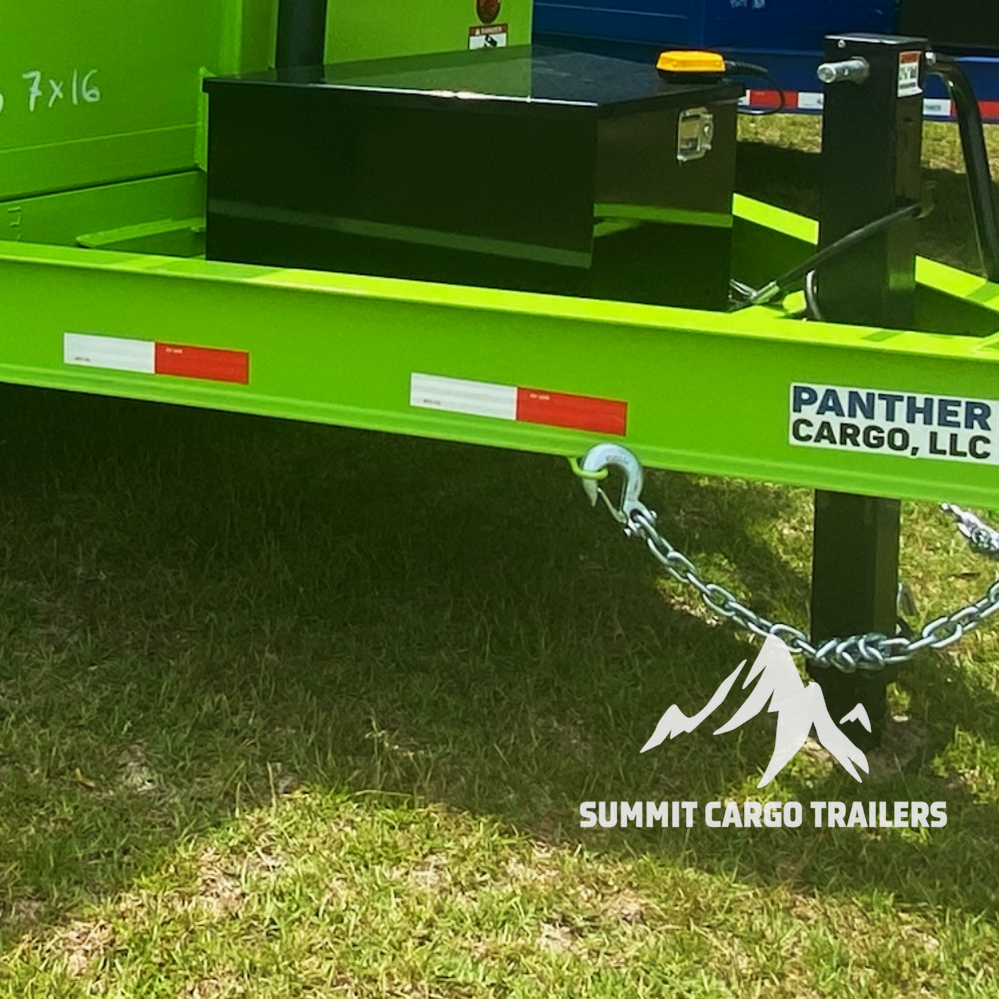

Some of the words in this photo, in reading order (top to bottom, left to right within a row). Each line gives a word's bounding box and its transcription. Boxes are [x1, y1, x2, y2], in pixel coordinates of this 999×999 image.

[22, 69, 100, 112] 7x16
[792, 385, 992, 431] PANTHER
[792, 418, 919, 456] CARGO,
[929, 430, 992, 459] LLC
